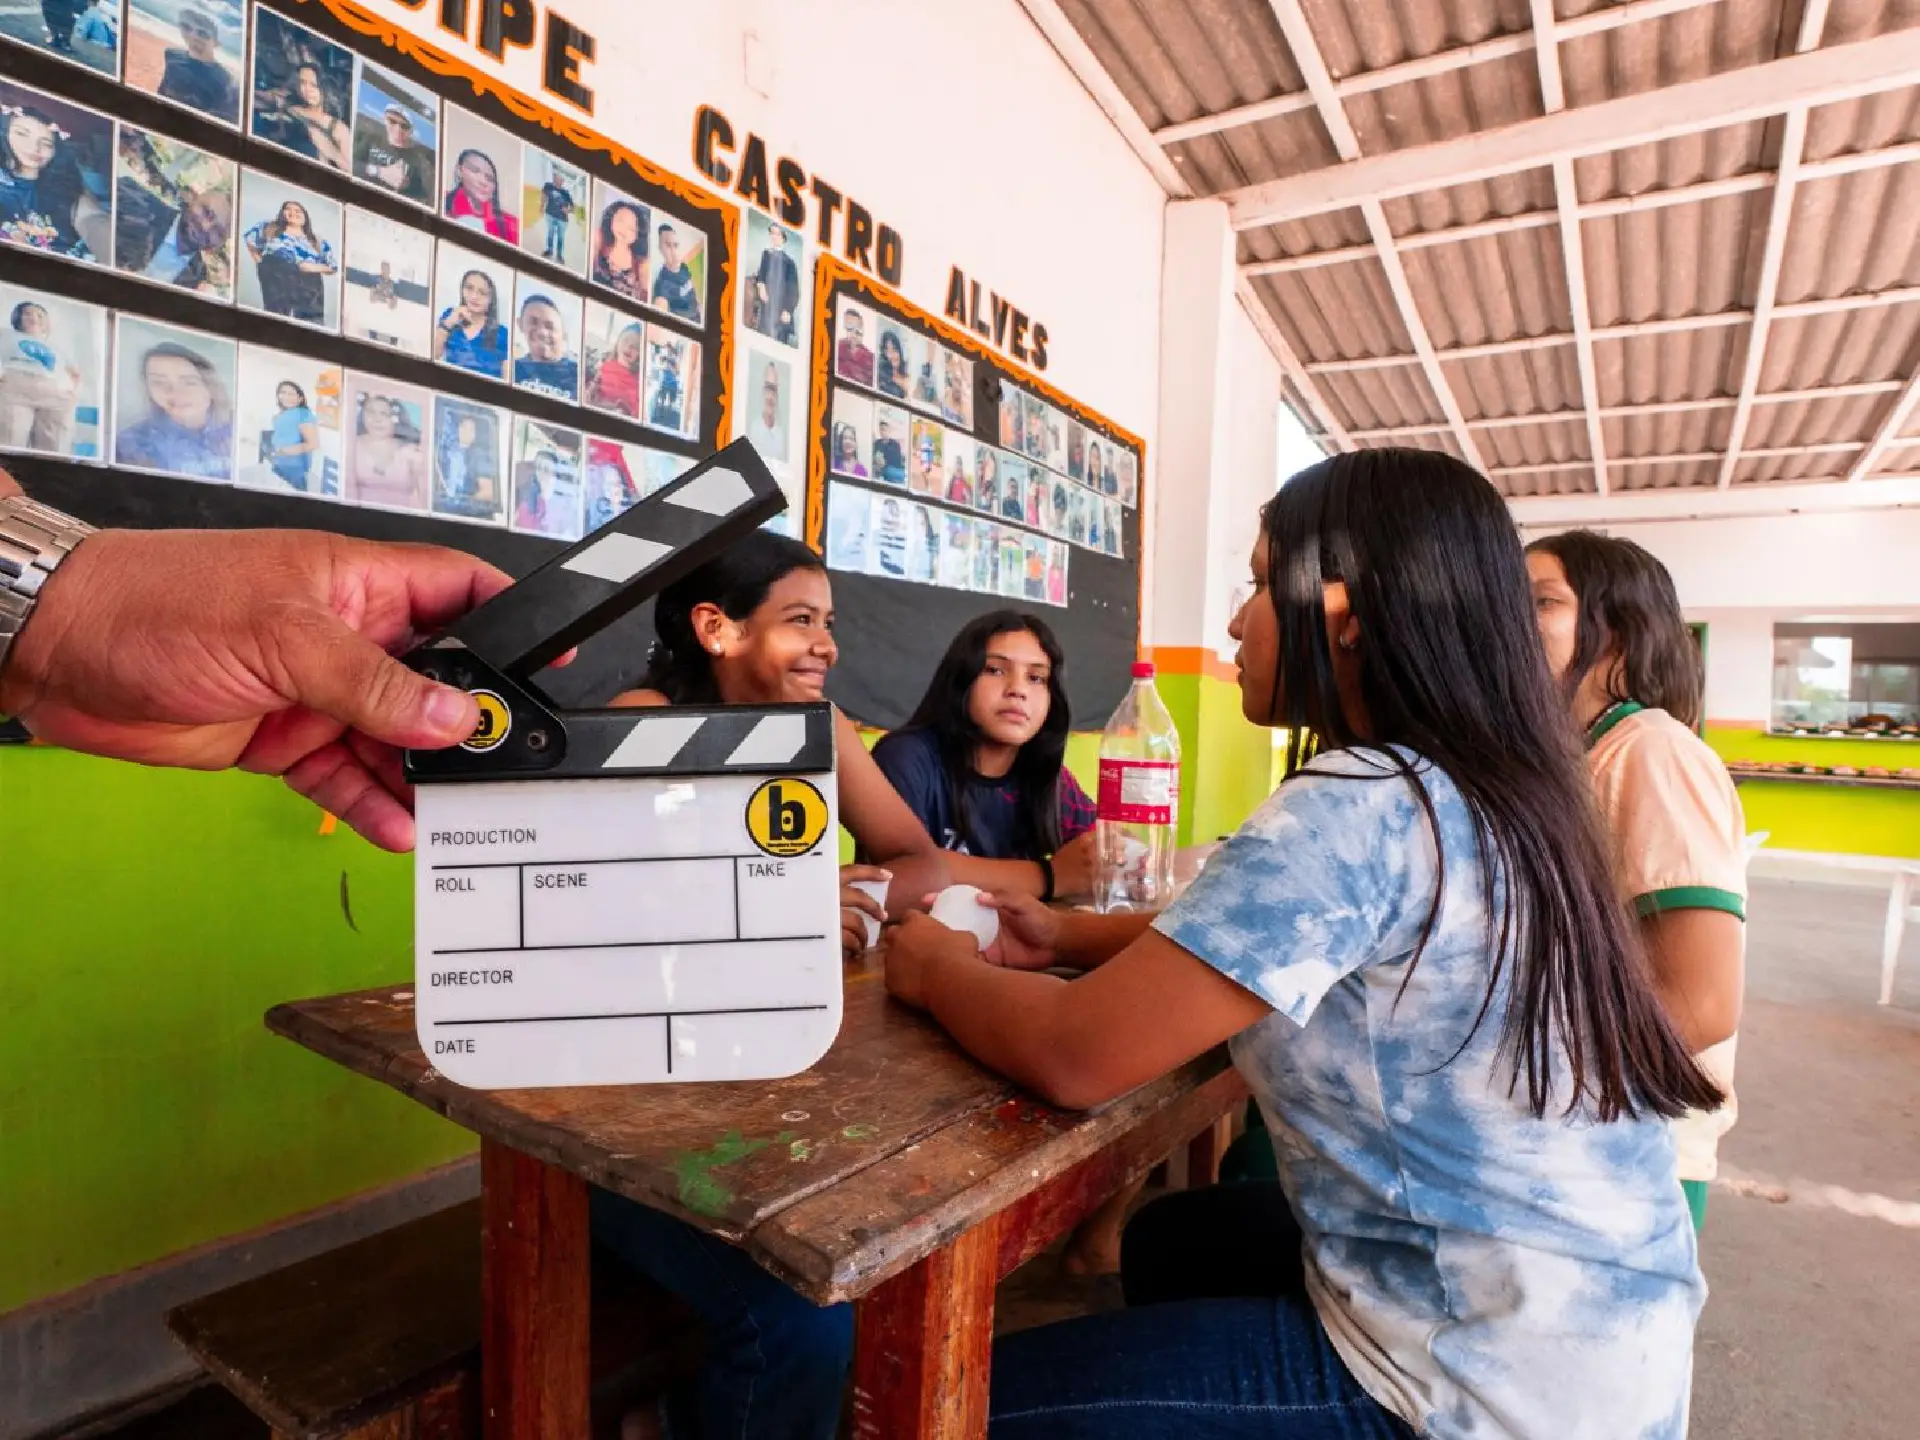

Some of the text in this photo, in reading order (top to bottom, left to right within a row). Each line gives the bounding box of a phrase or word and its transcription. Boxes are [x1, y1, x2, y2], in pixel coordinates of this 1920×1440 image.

[691, 103, 904, 289] CASTRO
[944, 263, 1050, 371] ALVES
[431, 829, 537, 846] PRODUCTION
[746, 861, 786, 877] TAKE
[435, 877, 475, 892] ROLL
[534, 873, 588, 889] SCENE
[431, 970, 514, 987] DIRECTOR
[434, 1039, 476, 1055] DATE
